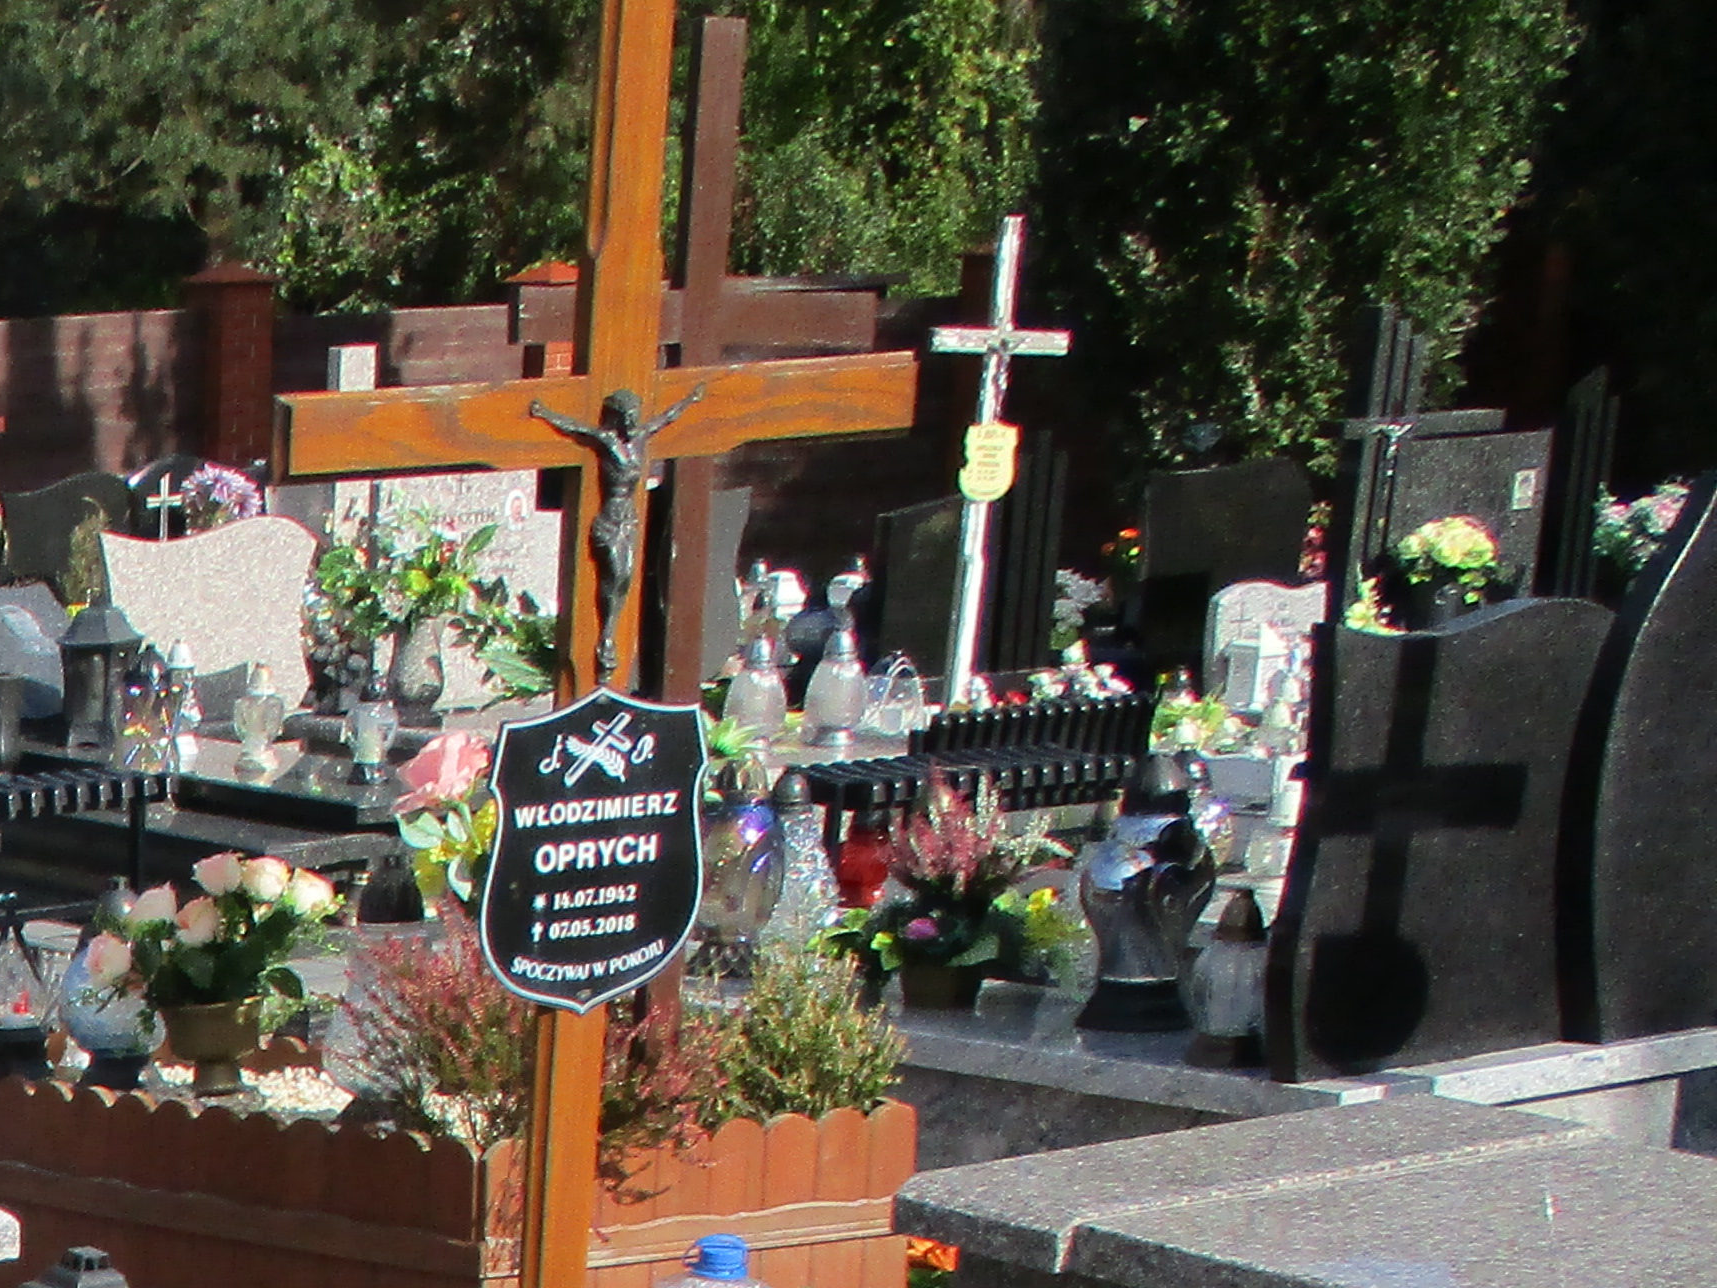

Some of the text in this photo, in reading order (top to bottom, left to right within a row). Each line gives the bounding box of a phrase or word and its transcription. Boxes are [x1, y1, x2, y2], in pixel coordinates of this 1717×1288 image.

[515, 790, 680, 830] WŁODZIMIERZ
[534, 834, 660, 874] OPRYCH
[548, 914, 636, 940] 07.05.2018
[510, 938, 665, 981] SPOCZYWAJ W POKOJU
